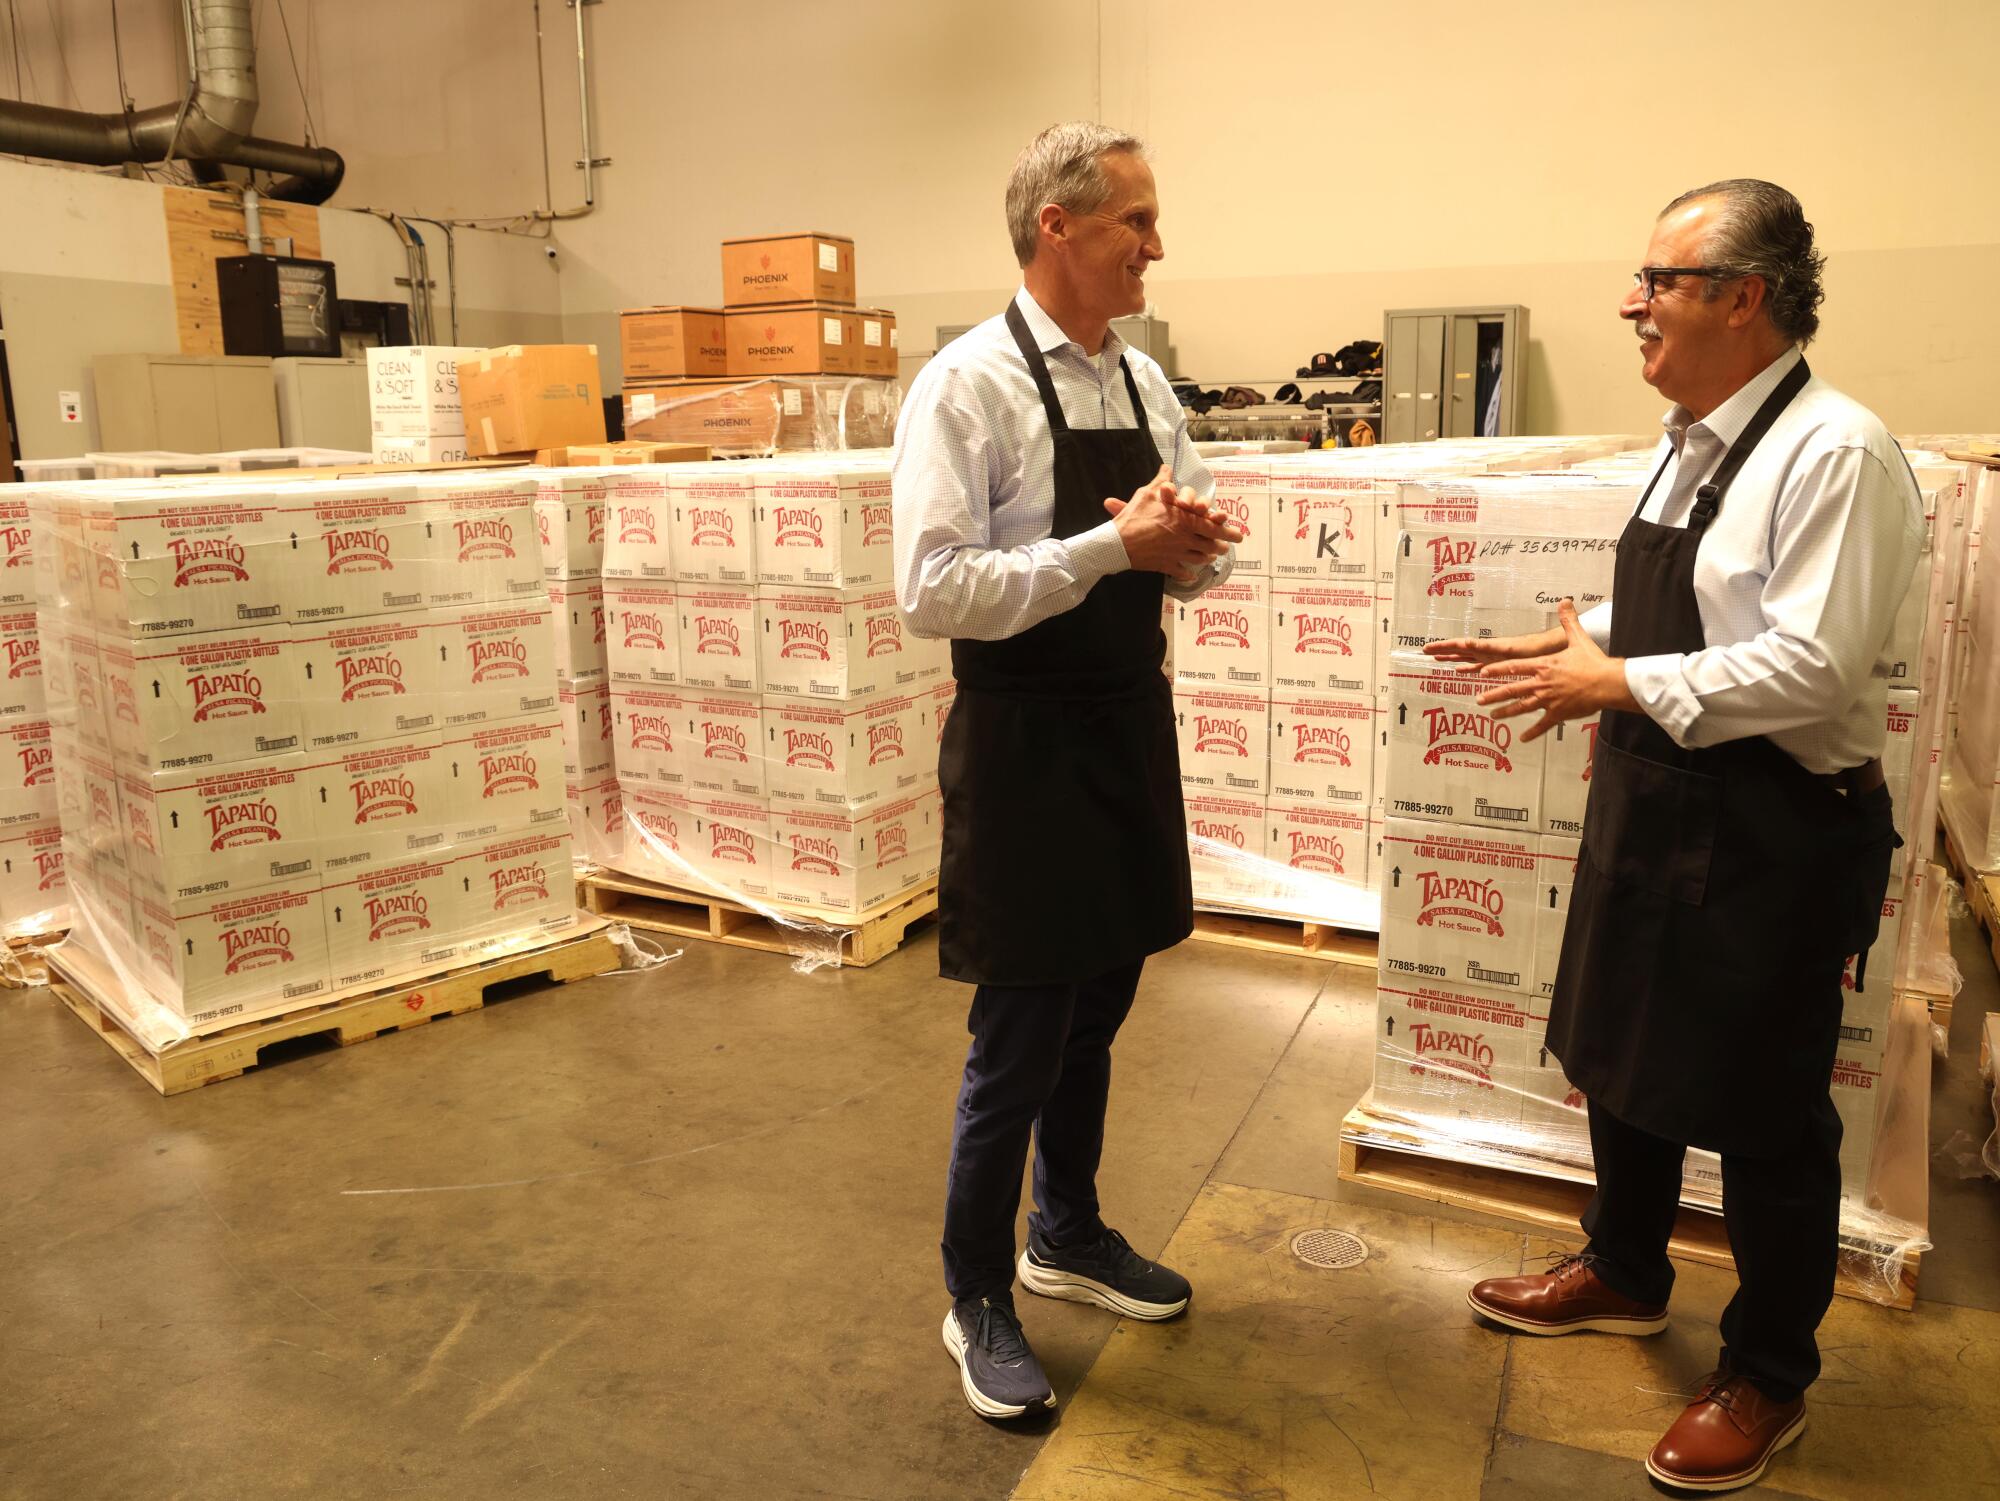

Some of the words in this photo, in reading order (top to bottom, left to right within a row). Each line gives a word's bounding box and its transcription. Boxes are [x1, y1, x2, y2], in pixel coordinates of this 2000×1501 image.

[744, 273, 788, 285] PHOENIX
[700, 347, 726, 356] PHOEN
[748, 346, 794, 356] PHOENIX
[378, 361, 411, 376] CLEAN
[436, 360, 457, 375] CLE
[376, 380, 382, 394] &
[385, 380, 414, 394] SOFT
[434, 380, 443, 394] &
[704, 418, 751, 428] PHOENIX
[380, 450, 413, 464] CLEAN
[160, 519, 165, 528] 4
[166, 518, 180, 528] ONE
[181, 516, 206, 528] GALLON
[208, 514, 234, 526] PLASTIC
[236, 512, 263, 523] BOTTLES
[772, 507, 822, 534] TAPATÍO
[860, 506, 892, 534] TAPATÍ
[1424, 510, 1429, 522] 4
[1431, 510, 1446, 522] ONE
[1448, 510, 1477, 522] GALLON
[453, 517, 513, 547] TAPATÍO
[321, 529, 390, 561] TAPATÍO
[167, 535, 244, 572] TAPATÍO
[1426, 536, 1477, 576] TAPA
[1277, 566, 1317, 574] 77885-99270
[193, 577, 208, 585] Hot
[209, 576, 232, 584] Sauce
[1442, 573, 1466, 585] SALSA
[430, 592, 472, 603] 77885-99270
[1449, 588, 1466, 596] Hot
[296, 606, 344, 618] 77885-99270
[142, 619, 194, 632] 77885-99270
[1194, 608, 1249, 636] TAPATÍO
[1294, 614, 1352, 644] TAPATÍO
[778, 618, 828, 648] TAPATÍO
[2, 639, 40, 666] TAPA
[180, 656, 185, 666] 4
[186, 656, 199, 666] ONE
[200, 652, 225, 664] GALLON
[226, 648, 252, 660] PLASTIC
[252, 645, 280, 658] BOTTLES
[468, 637, 526, 669] TAPATÍO
[336, 652, 402, 687] TAPATÍO
[1178, 670, 1216, 680] 77885-99270
[1432, 668, 1440, 676] DO
[186, 668, 261, 708] TAPATÍO
[1276, 678, 1316, 688] 77885-99270
[1420, 681, 1425, 692] 4
[1426, 682, 1442, 694] ONE
[1444, 682, 1472, 696] GALLON
[212, 712, 226, 720] Hot
[228, 710, 249, 718] Sauce
[446, 711, 486, 724] 77885-99270
[1294, 706, 1304, 716] ONE
[1306, 707, 1324, 716] GALLON
[1326, 709, 1346, 718] PLASTIC
[1348, 710, 1370, 720] BOTTLES
[1193, 715, 1248, 744] TAPATÍO
[312, 732, 358, 746] 77885-99270
[784, 728, 833, 759] TAPATÍO
[1292, 724, 1350, 753] TAPATÍO
[1437, 744, 1462, 754] SALSA
[1464, 745, 1499, 759] PICANTE
[161, 754, 212, 769] 77885-99270
[478, 751, 536, 784] TAPATÍO
[1445, 758, 1462, 767] Hot
[1464, 760, 1489, 770] Sauce
[1182, 775, 1214, 785] 7885-99270
[350, 774, 414, 808] TAPATÍO
[1275, 787, 1314, 798] 77885-99270
[1394, 800, 1454, 816] 77885-99270
[0, 812, 40, 824] 7885-99270
[204, 798, 278, 838] TAPATÍO
[1550, 820, 1584, 832] 77885-
[456, 826, 497, 840] 77885-99270
[1288, 832, 1344, 862] TAPATÍO
[1463, 838, 1484, 846] BELOW
[1486, 842, 1510, 850] DOTTED
[1512, 844, 1526, 852] LINE
[326, 852, 371, 868] 77885-99270
[1414, 845, 1418, 856] 4
[1420, 846, 1436, 858] ONE
[1437, 848, 1466, 862] GALLON
[1467, 852, 1500, 866] PLASTIC
[1501, 856, 1535, 870] BOTTLES
[489, 861, 546, 896] TAPATÍO
[178, 881, 229, 897] 77885-99270
[1416, 870, 1504, 915] TAPATÍO
[363, 890, 428, 925] TAPATÍO
[1430, 908, 1455, 916] SALSA
[1457, 908, 1492, 924] PICANTE
[1438, 920, 1455, 930] Hot
[1456, 923, 1482, 933] Sauce
[218, 921, 290, 961] TAPATÍO
[1388, 959, 1446, 977] 77885-99270
[340, 969, 384, 985] 77885-99270
[1428, 989, 1440, 997] NOT
[1455, 994, 1476, 1002] BELOW
[1477, 998, 1500, 1008] DOTTED
[1502, 1002, 1516, 1010] LINE
[194, 1004, 243, 1020] 77885-99270
[1407, 998, 1412, 1008] 4
[1414, 998, 1428, 1010] ONE
[1430, 1000, 1458, 1016] GALLON
[1459, 1006, 1490, 1022] PLASTIC
[1492, 1012, 1524, 1028] BOTTLES
[1409, 1024, 1494, 1069] TAPATÍO
[1846, 1060, 1862, 1068] LINE
[1832, 1071, 1872, 1088] BOTTLES
